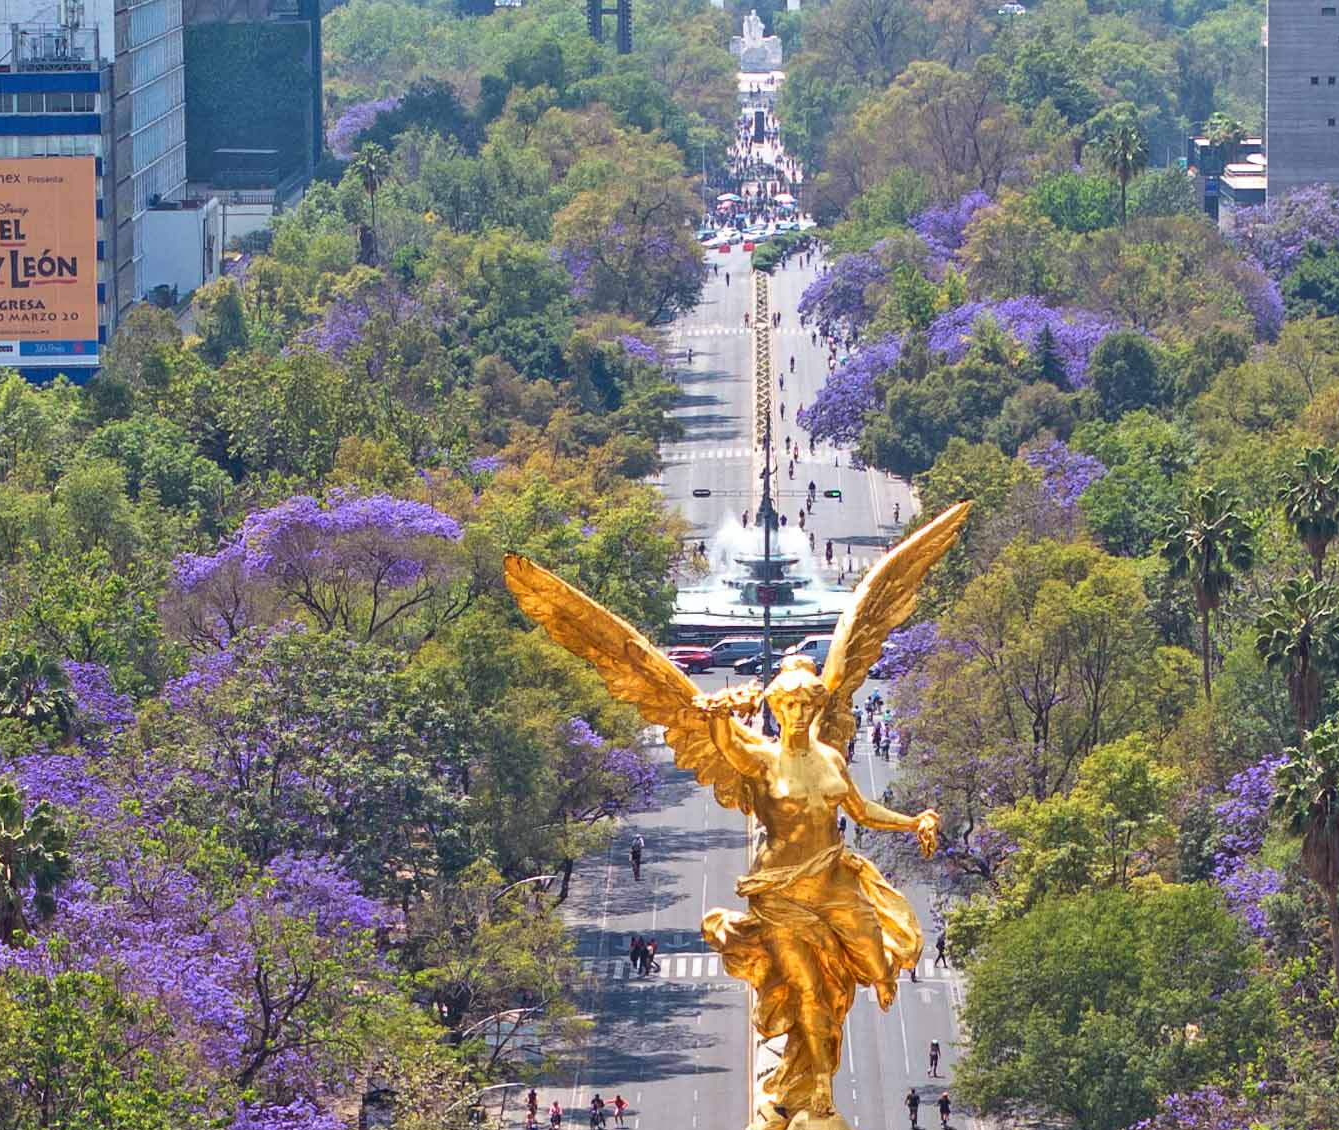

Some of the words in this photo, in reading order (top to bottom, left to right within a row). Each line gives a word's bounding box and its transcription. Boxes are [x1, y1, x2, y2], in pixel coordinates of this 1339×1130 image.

[0, 219, 26, 241] EL
[9, 248, 78, 289] LEÓN
[9, 312, 58, 322] MARZO
[62, 312, 79, 322] 20
